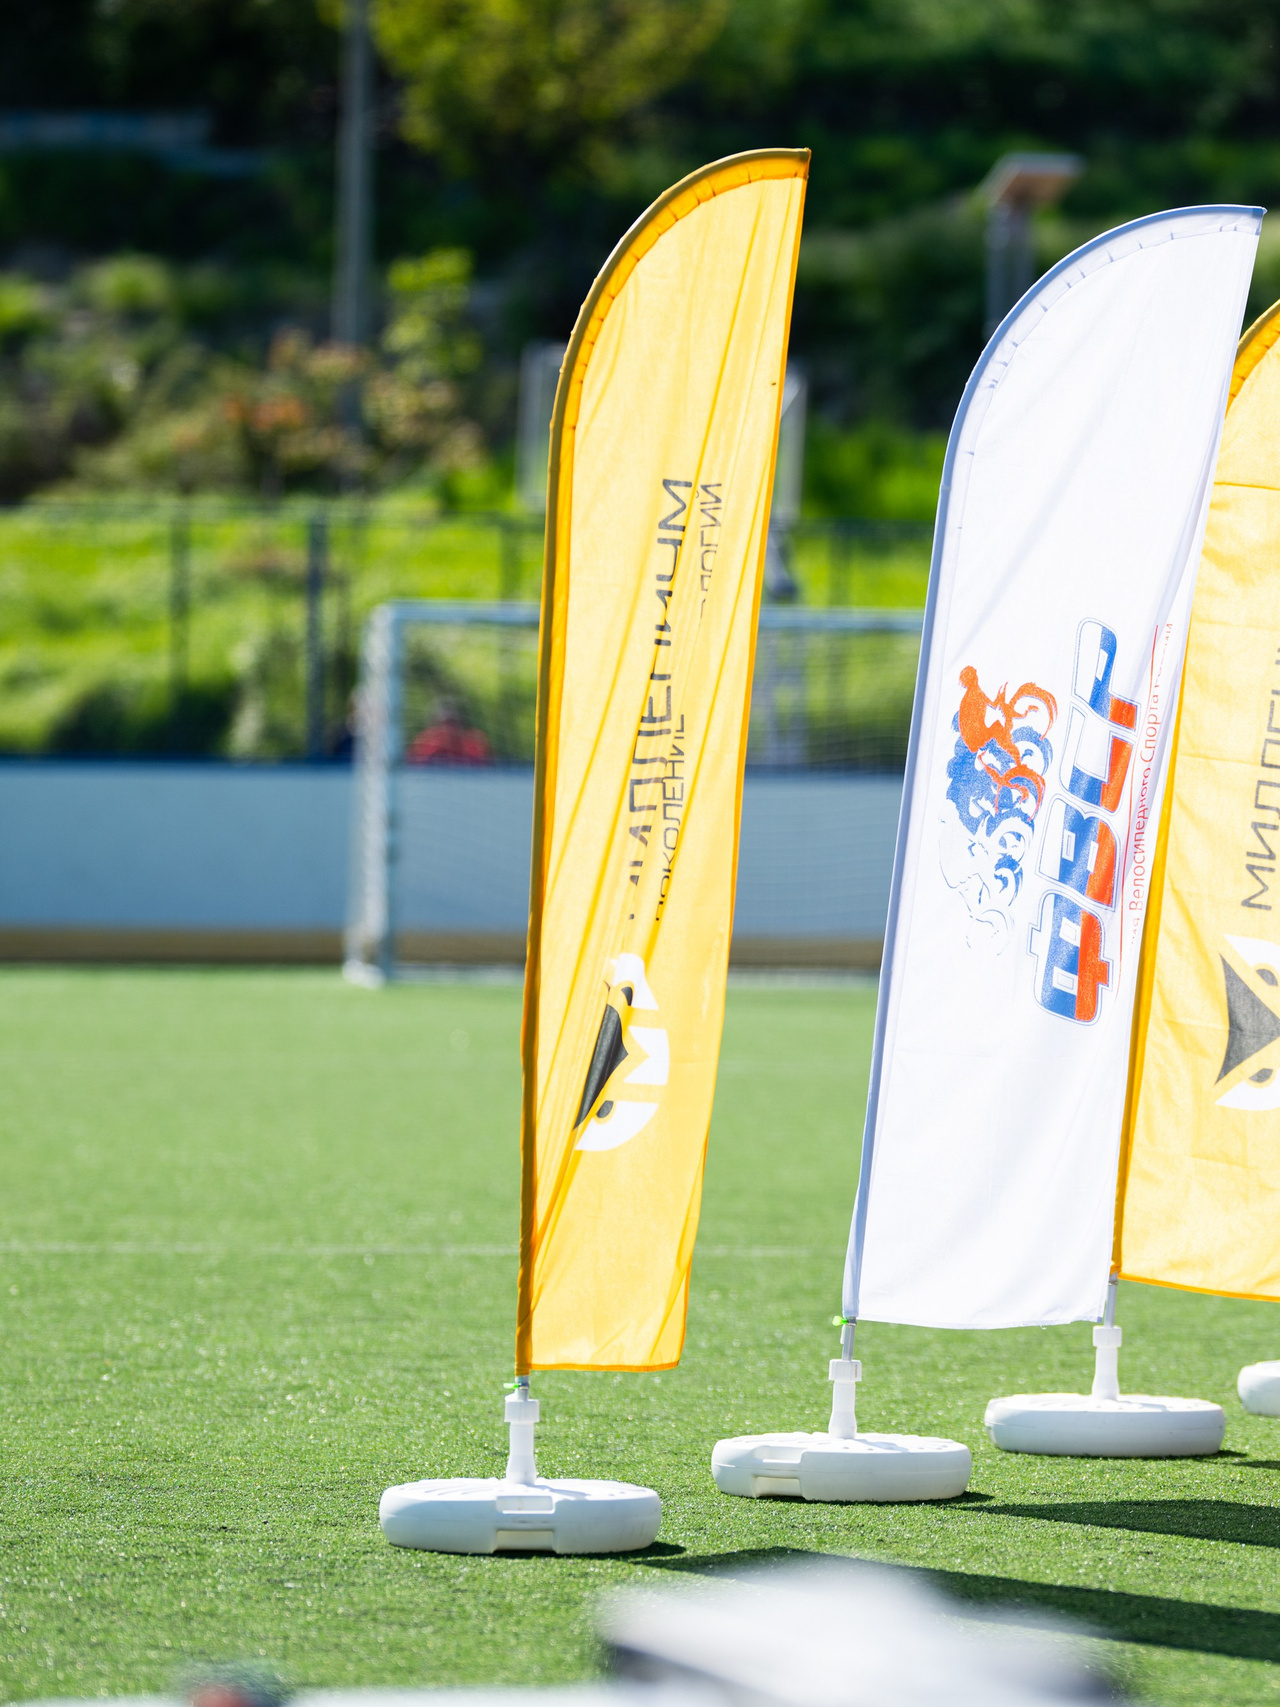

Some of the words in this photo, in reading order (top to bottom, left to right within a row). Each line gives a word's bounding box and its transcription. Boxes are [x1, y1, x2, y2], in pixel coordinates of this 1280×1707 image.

[1139, 694, 1162, 763] Спорта
[1026, 616, 1142, 1027] ФВСР
[1128, 767, 1151, 911] Велосипедного
